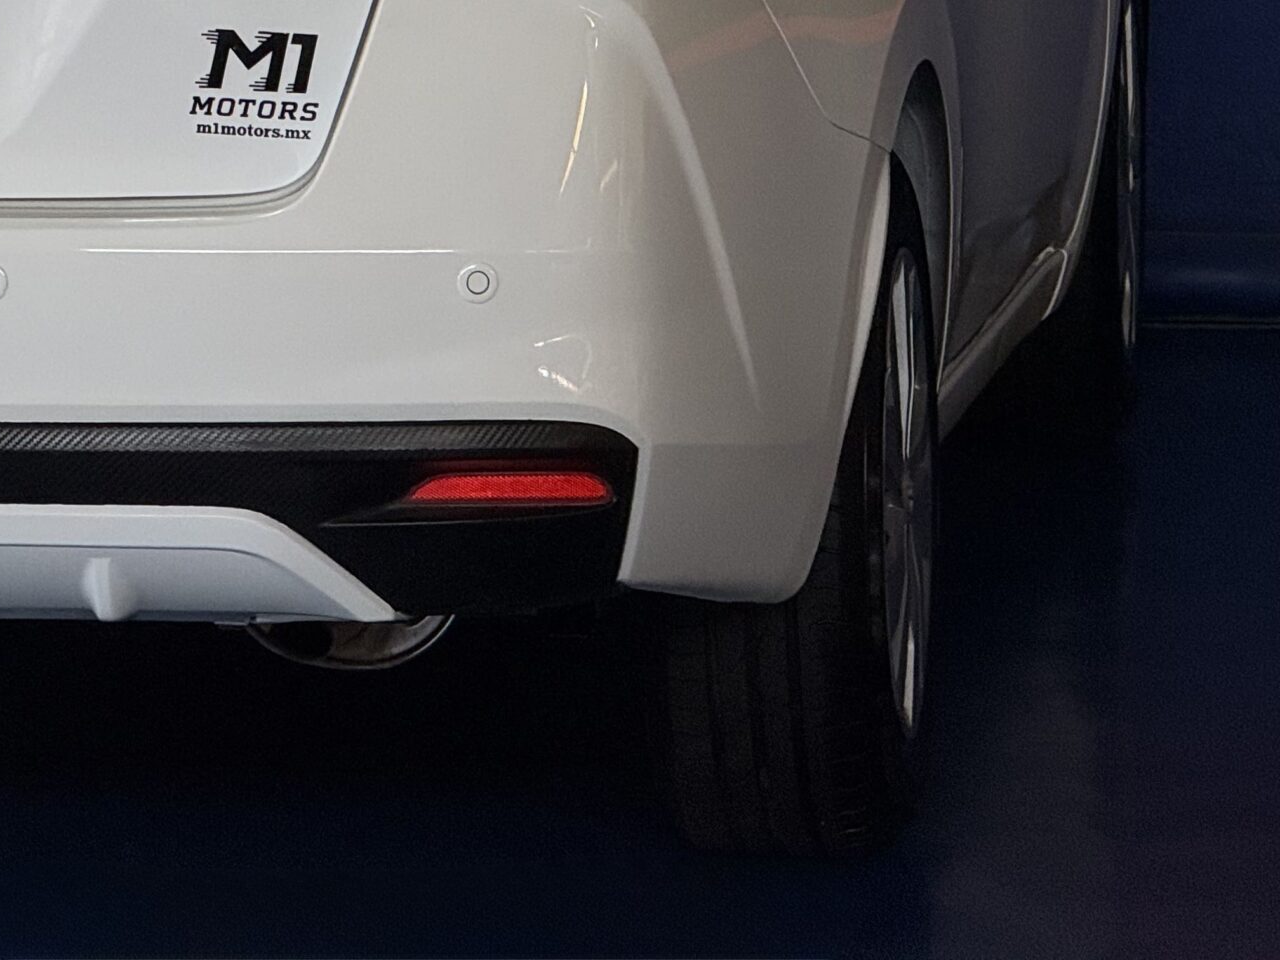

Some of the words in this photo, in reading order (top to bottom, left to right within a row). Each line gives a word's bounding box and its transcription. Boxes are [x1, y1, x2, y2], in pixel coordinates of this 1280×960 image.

[195, 28, 319, 95] M1
[189, 96, 320, 122] MOTORS
[196, 122, 312, 140] m1motors.mx
